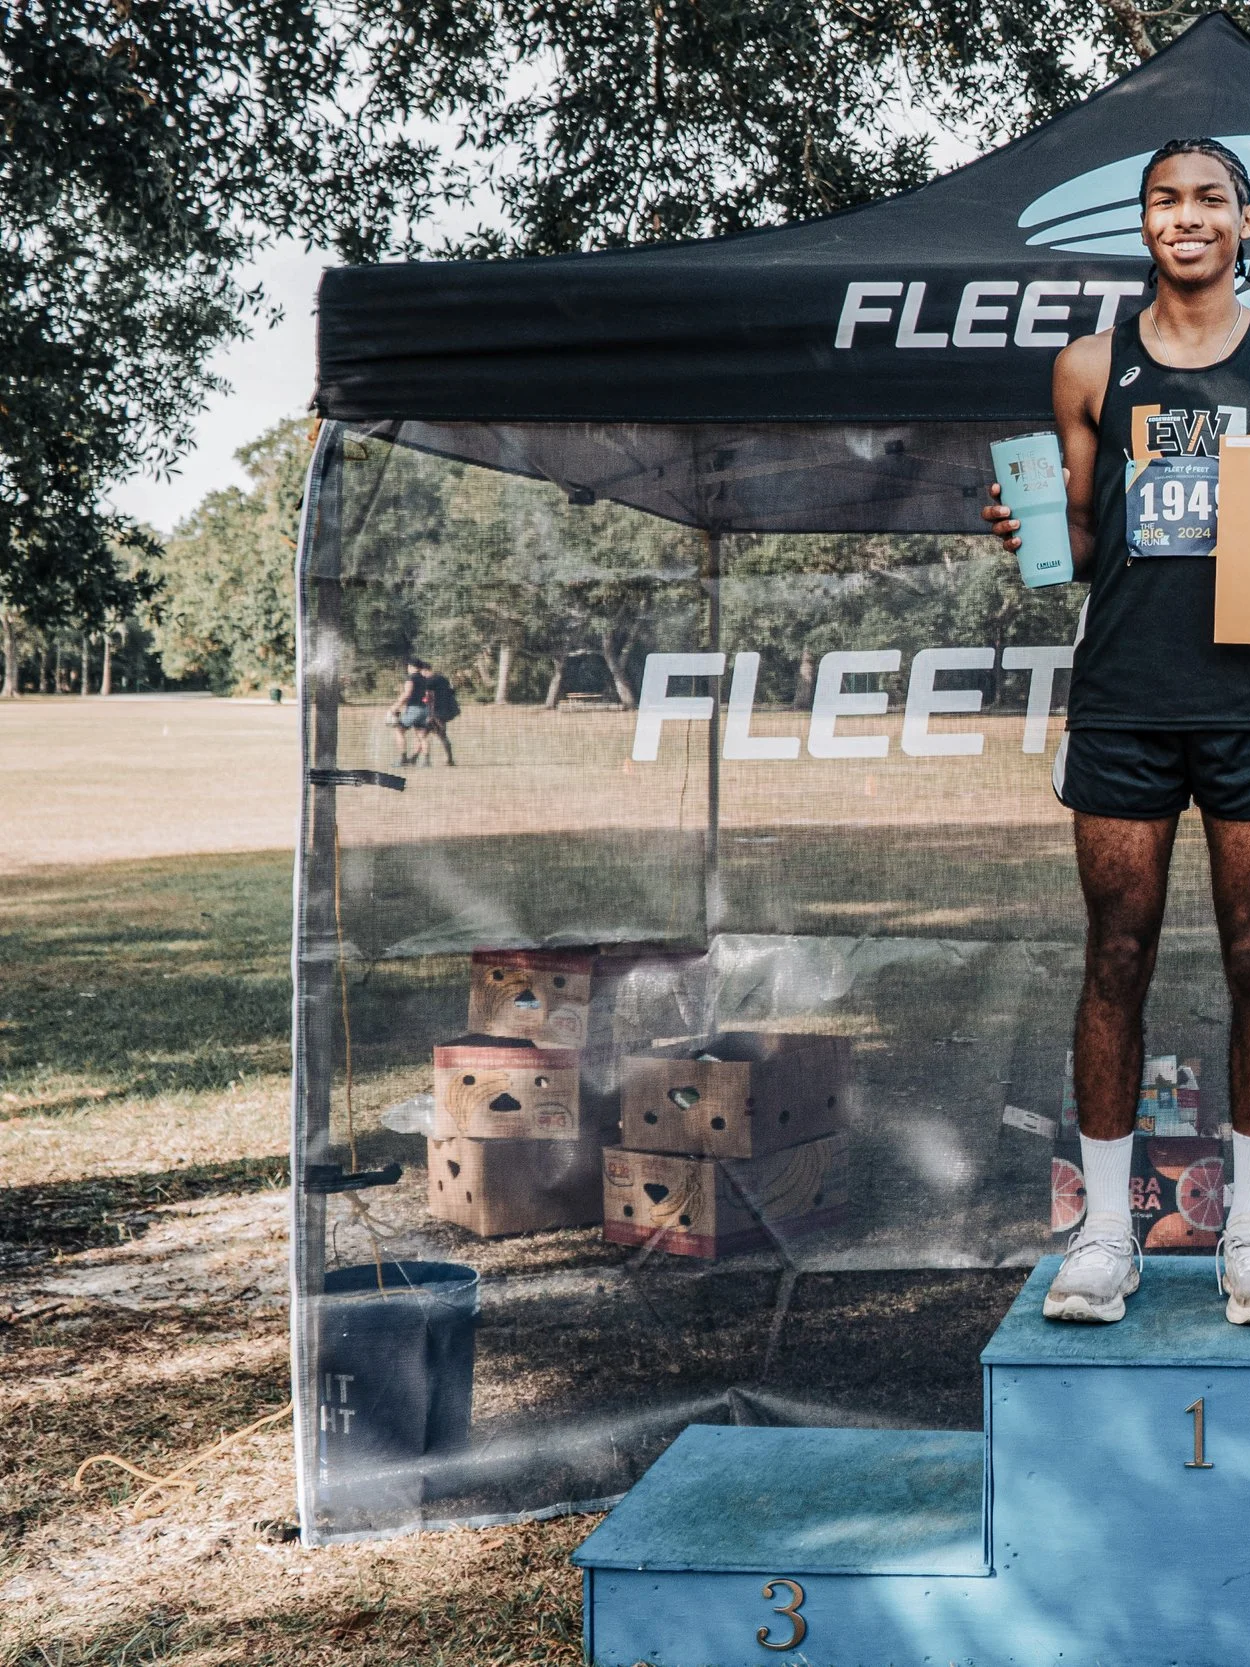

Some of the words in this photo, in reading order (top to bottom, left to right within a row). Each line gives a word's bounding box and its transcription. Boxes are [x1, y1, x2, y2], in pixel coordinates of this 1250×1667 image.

[834, 280, 1143, 349] FLEET
[1145, 408, 1233, 460] EW
[1139, 480, 1220, 522] 194
[1141, 528, 1164, 539] BIG
[1177, 527, 1212, 539] 2024
[1141, 538, 1161, 546] RUN
[632, 647, 1072, 762] FLEET
[1183, 1397, 1214, 1470] 1
[757, 1578, 806, 1651] 3
